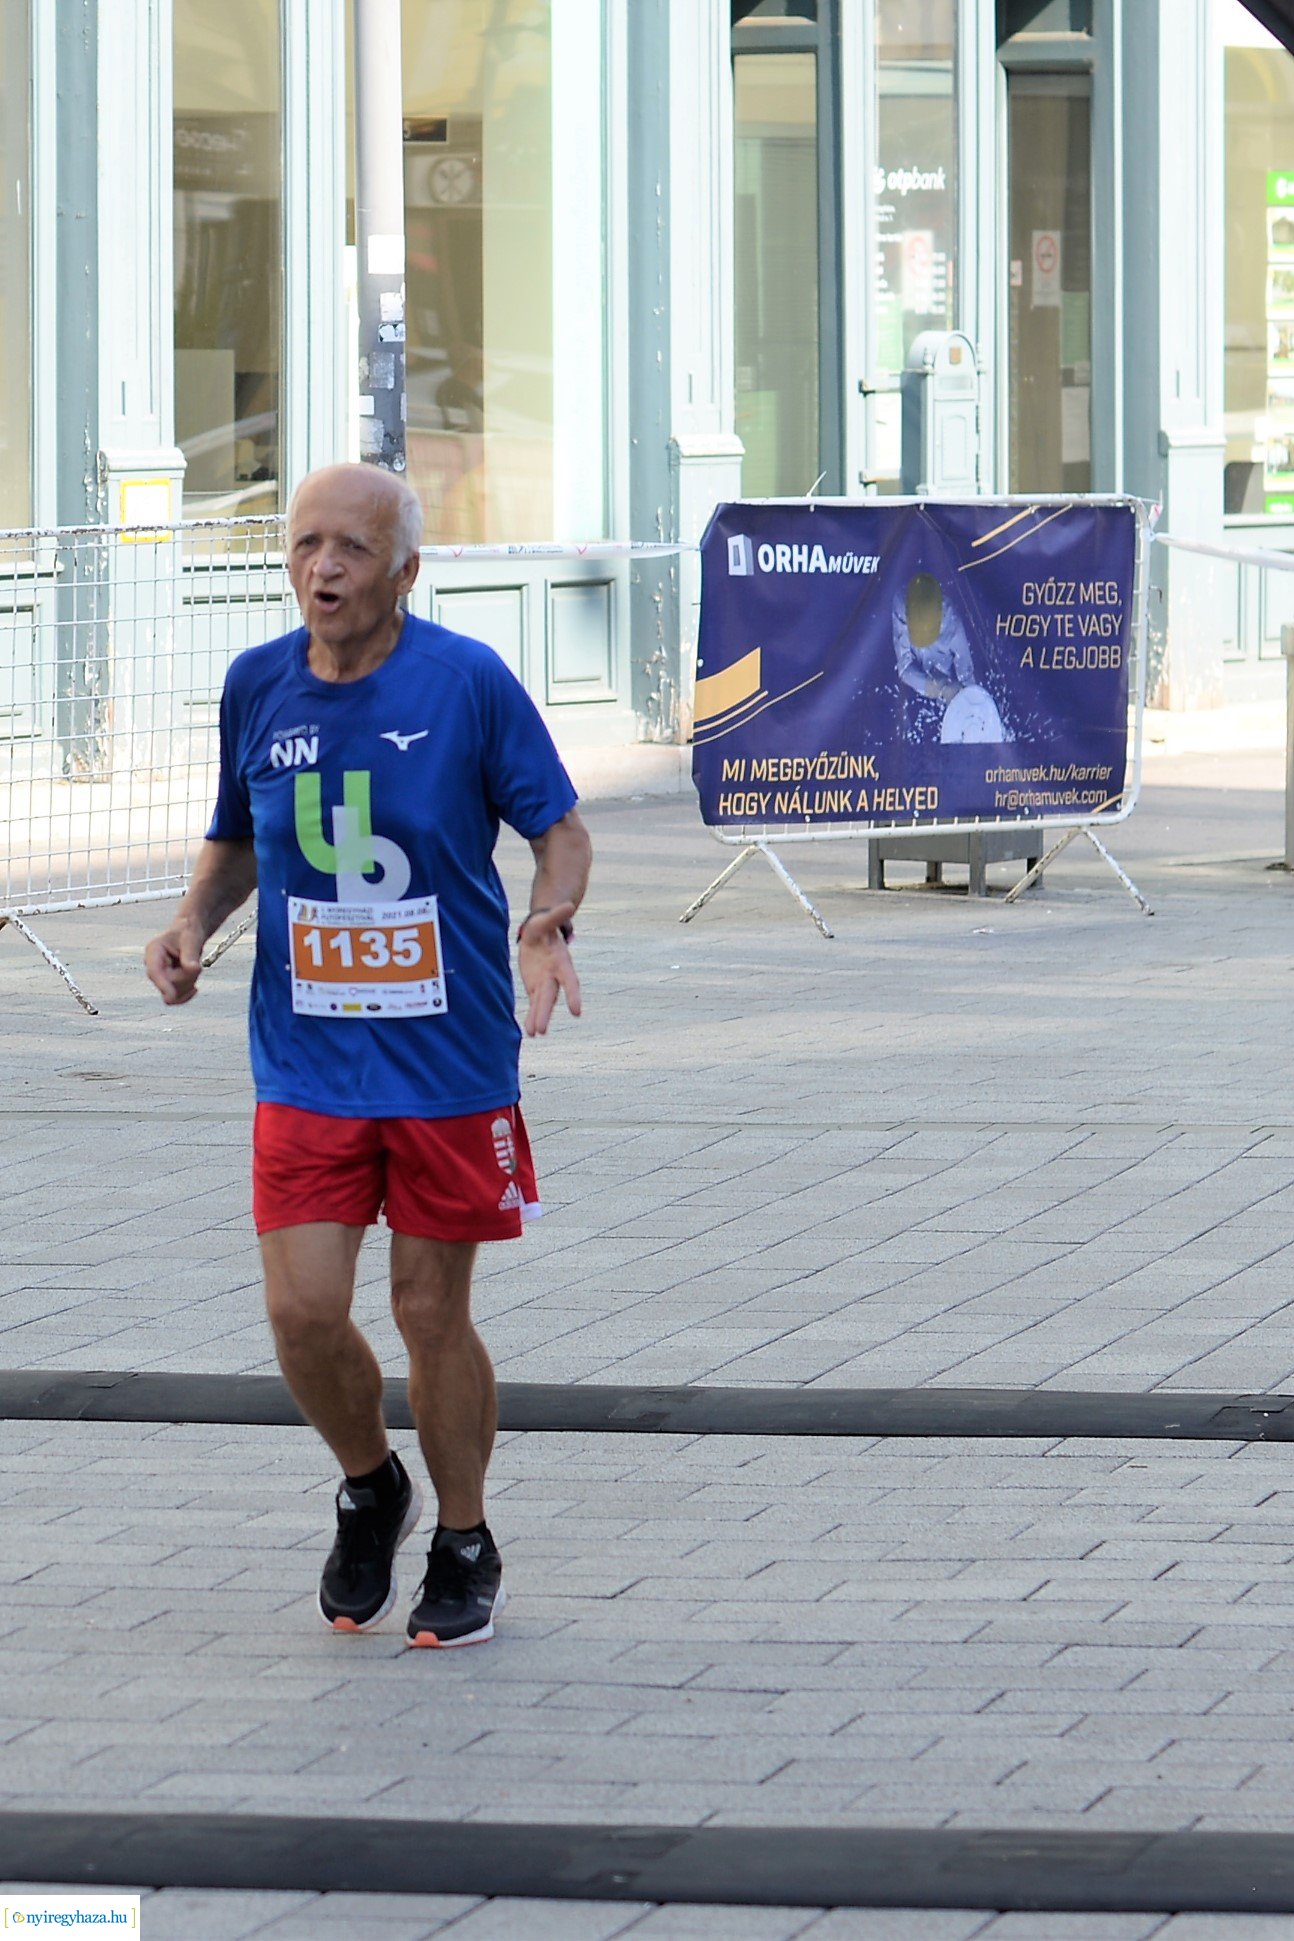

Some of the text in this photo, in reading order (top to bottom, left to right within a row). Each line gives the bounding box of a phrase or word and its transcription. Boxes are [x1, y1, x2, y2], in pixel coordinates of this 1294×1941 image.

[887, 166, 945, 196] otpbank
[1022, 576, 1123, 607] GYŐZZ MEG,
[995, 613, 1123, 638] HOGY TE VAGY
[1020, 646, 1121, 669] A LEGJOBB
[270, 736, 319, 768] NN
[721, 758, 746, 782] MI
[985, 763, 1113, 783] orhamuvek.hu/karrier
[718, 785, 939, 816] HOGY NÁLUNK A HELYED
[995, 788, 1107, 810] hr@orhamuvek.com
[303, 928, 423, 967] 1135
